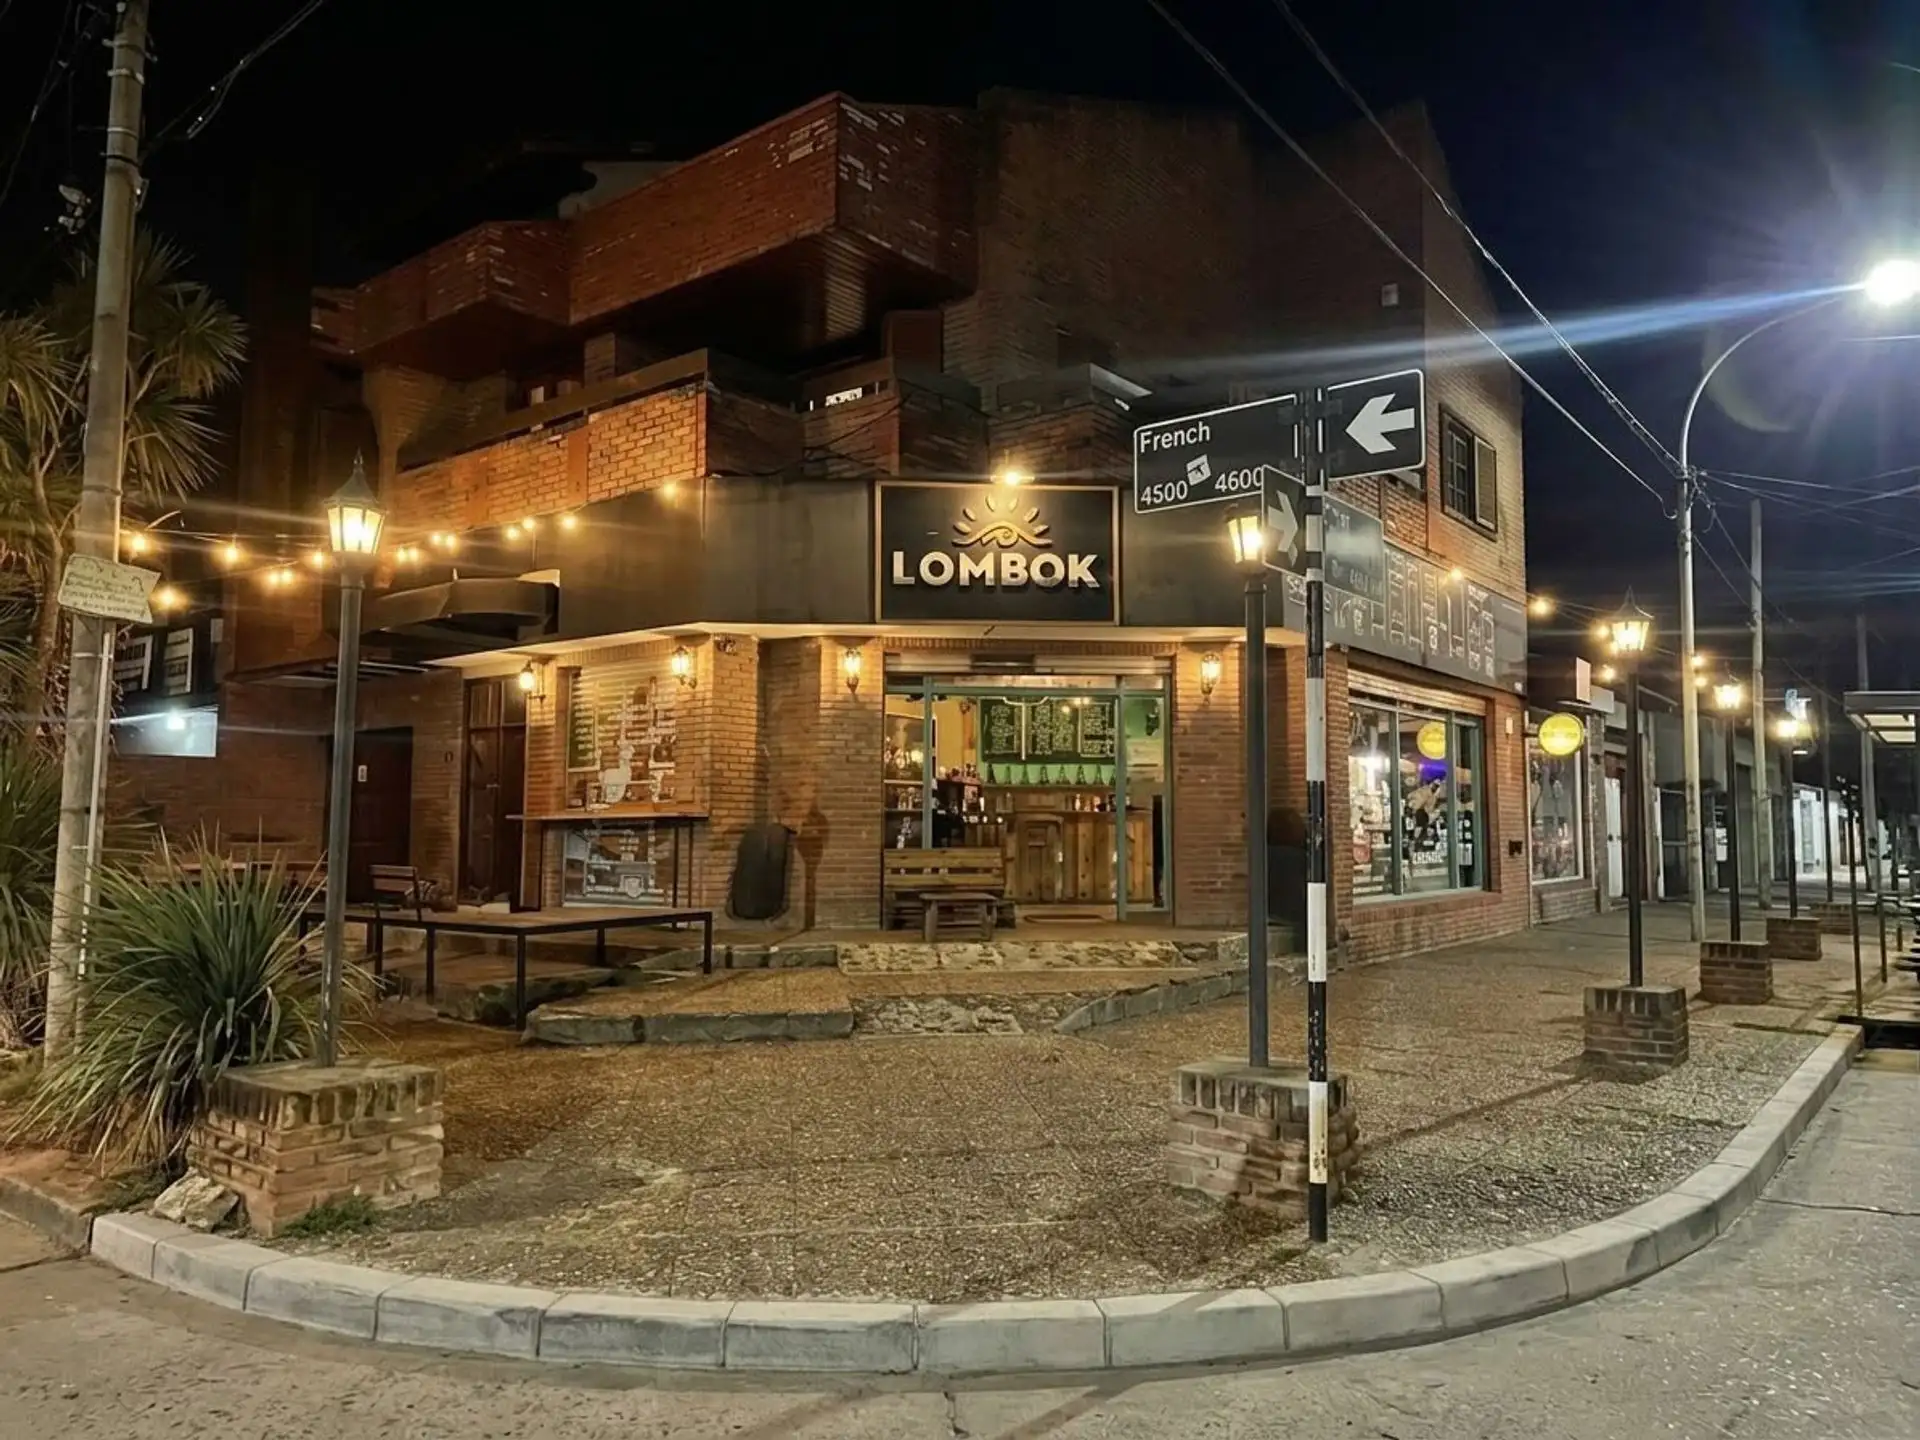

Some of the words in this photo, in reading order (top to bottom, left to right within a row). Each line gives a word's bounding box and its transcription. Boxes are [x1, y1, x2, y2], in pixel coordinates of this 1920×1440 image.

[1140, 421, 1211, 453] French
[1140, 480, 1188, 505] 4500
[892, 551, 1100, 588] LOMBOK
